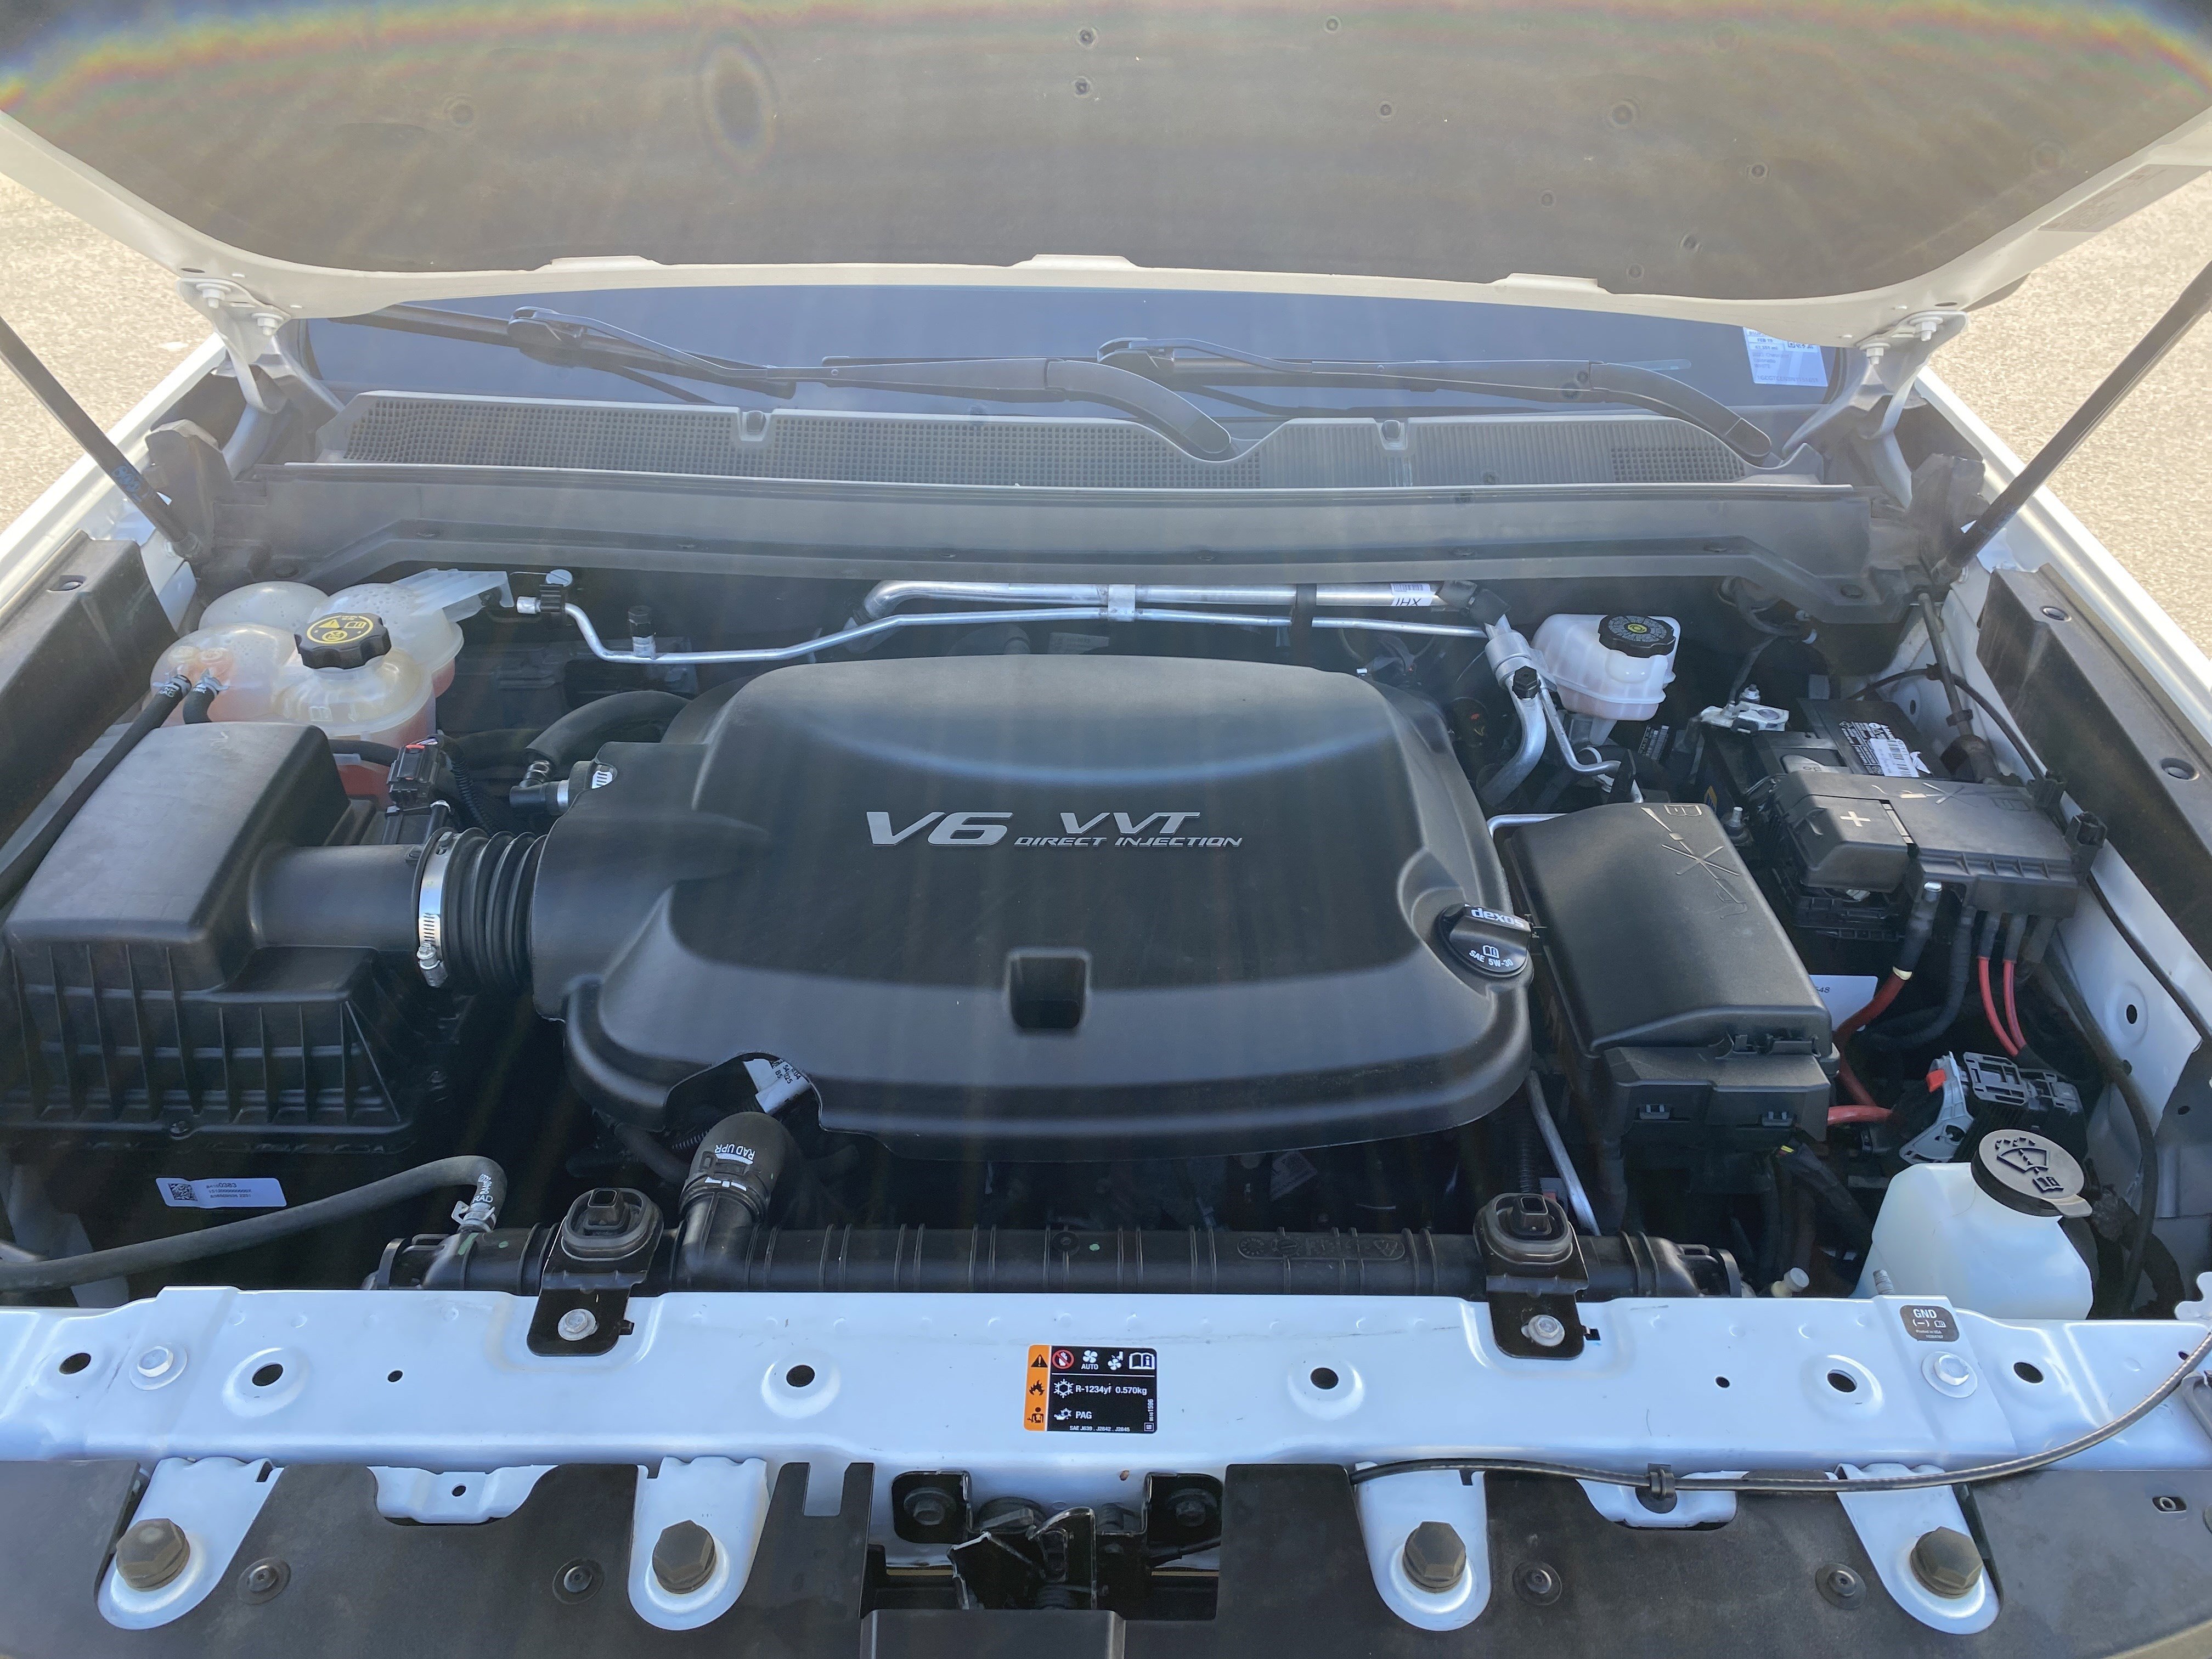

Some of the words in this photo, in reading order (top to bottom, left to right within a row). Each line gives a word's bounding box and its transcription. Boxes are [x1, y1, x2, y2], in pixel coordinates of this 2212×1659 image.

[866, 811, 1014, 846] V6
[1060, 811, 1201, 834] VVT
[1013, 836, 1108, 847] DIRECT
[1114, 837, 1243, 848] INJECTION
[1471, 907, 1525, 928] dexos
[1469, 950, 1486, 963] SAE
[1488, 958, 1514, 967] 5W-30
[714, 1143, 735, 1153] UPR
[736, 1146, 755, 1160] RAD
[472, 1195, 494, 1203] RAD
[1912, 1308, 1937, 1318] GND
[1075, 1385, 1112, 1395] R-1234yf
[1115, 1386, 1148, 1396] 0.570kg
[1075, 1411, 1093, 1419] PAG
